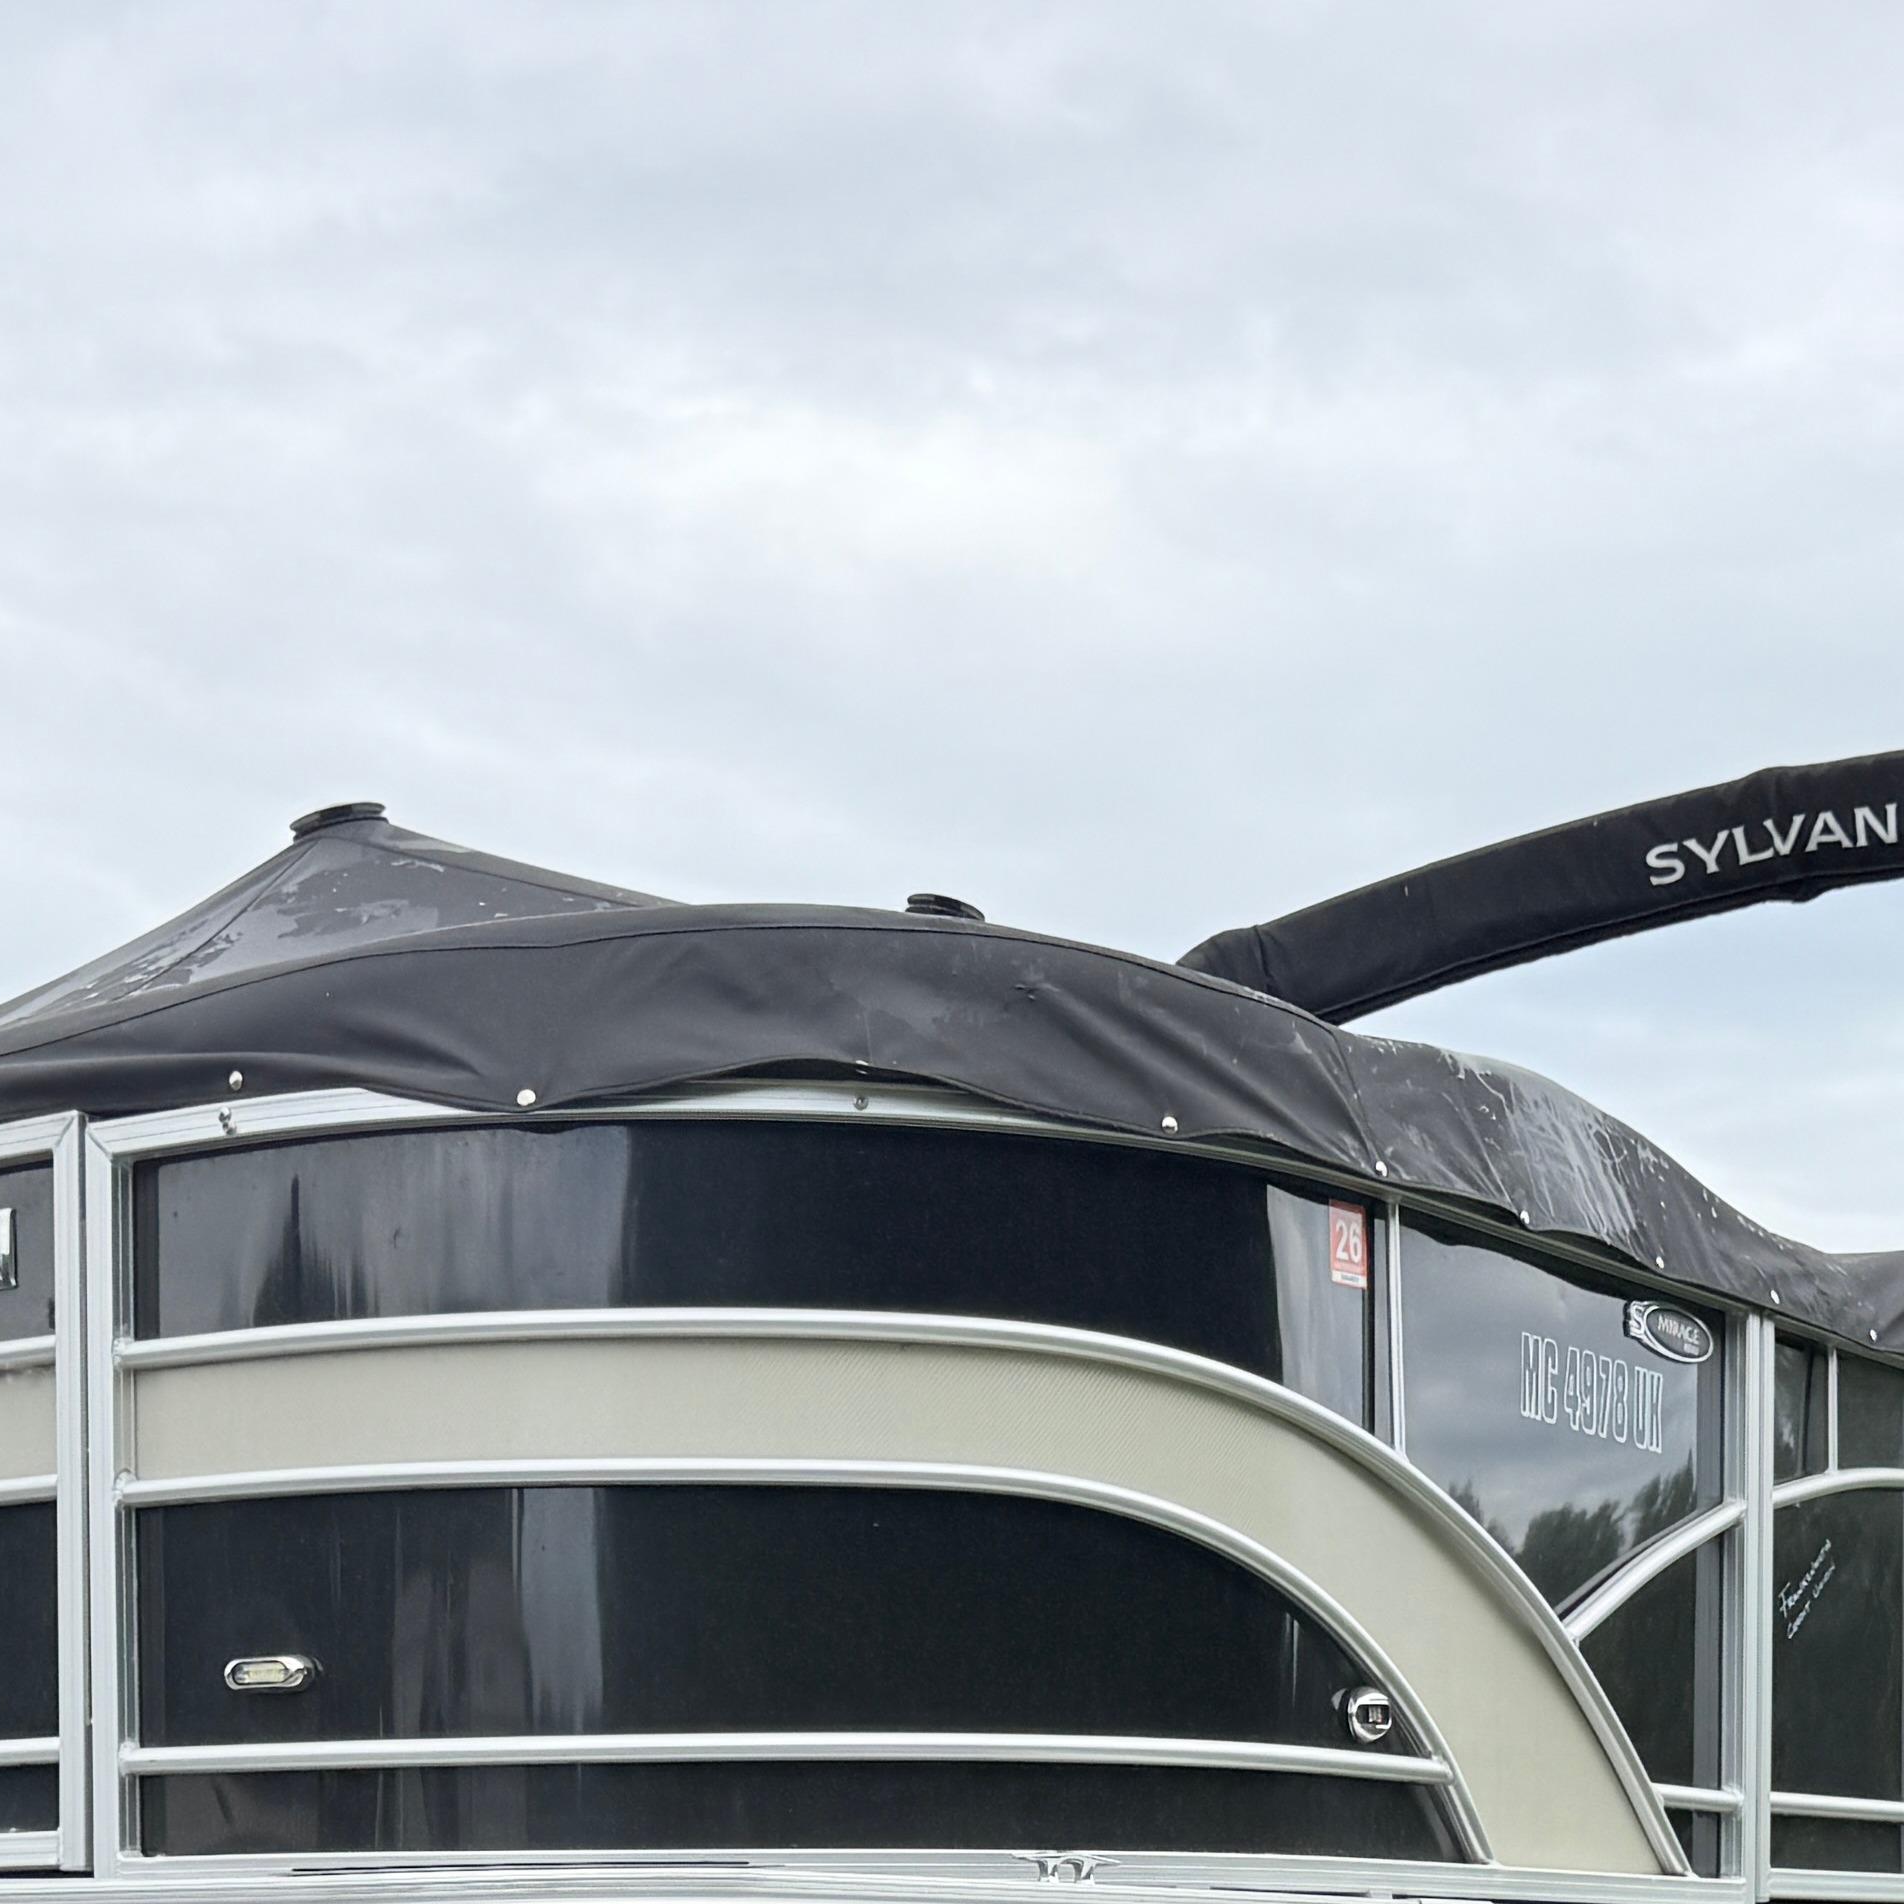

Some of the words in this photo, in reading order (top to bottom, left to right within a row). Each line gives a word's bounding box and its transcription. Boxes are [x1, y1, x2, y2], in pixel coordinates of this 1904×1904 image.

[1646, 802, 1898, 886] SYLVAN
[1336, 1219, 1363, 1263] 26
[1520, 1331, 1559, 1425] MC
[1563, 1346, 1628, 1444] 4978
[1633, 1365, 1663, 1454] UK
